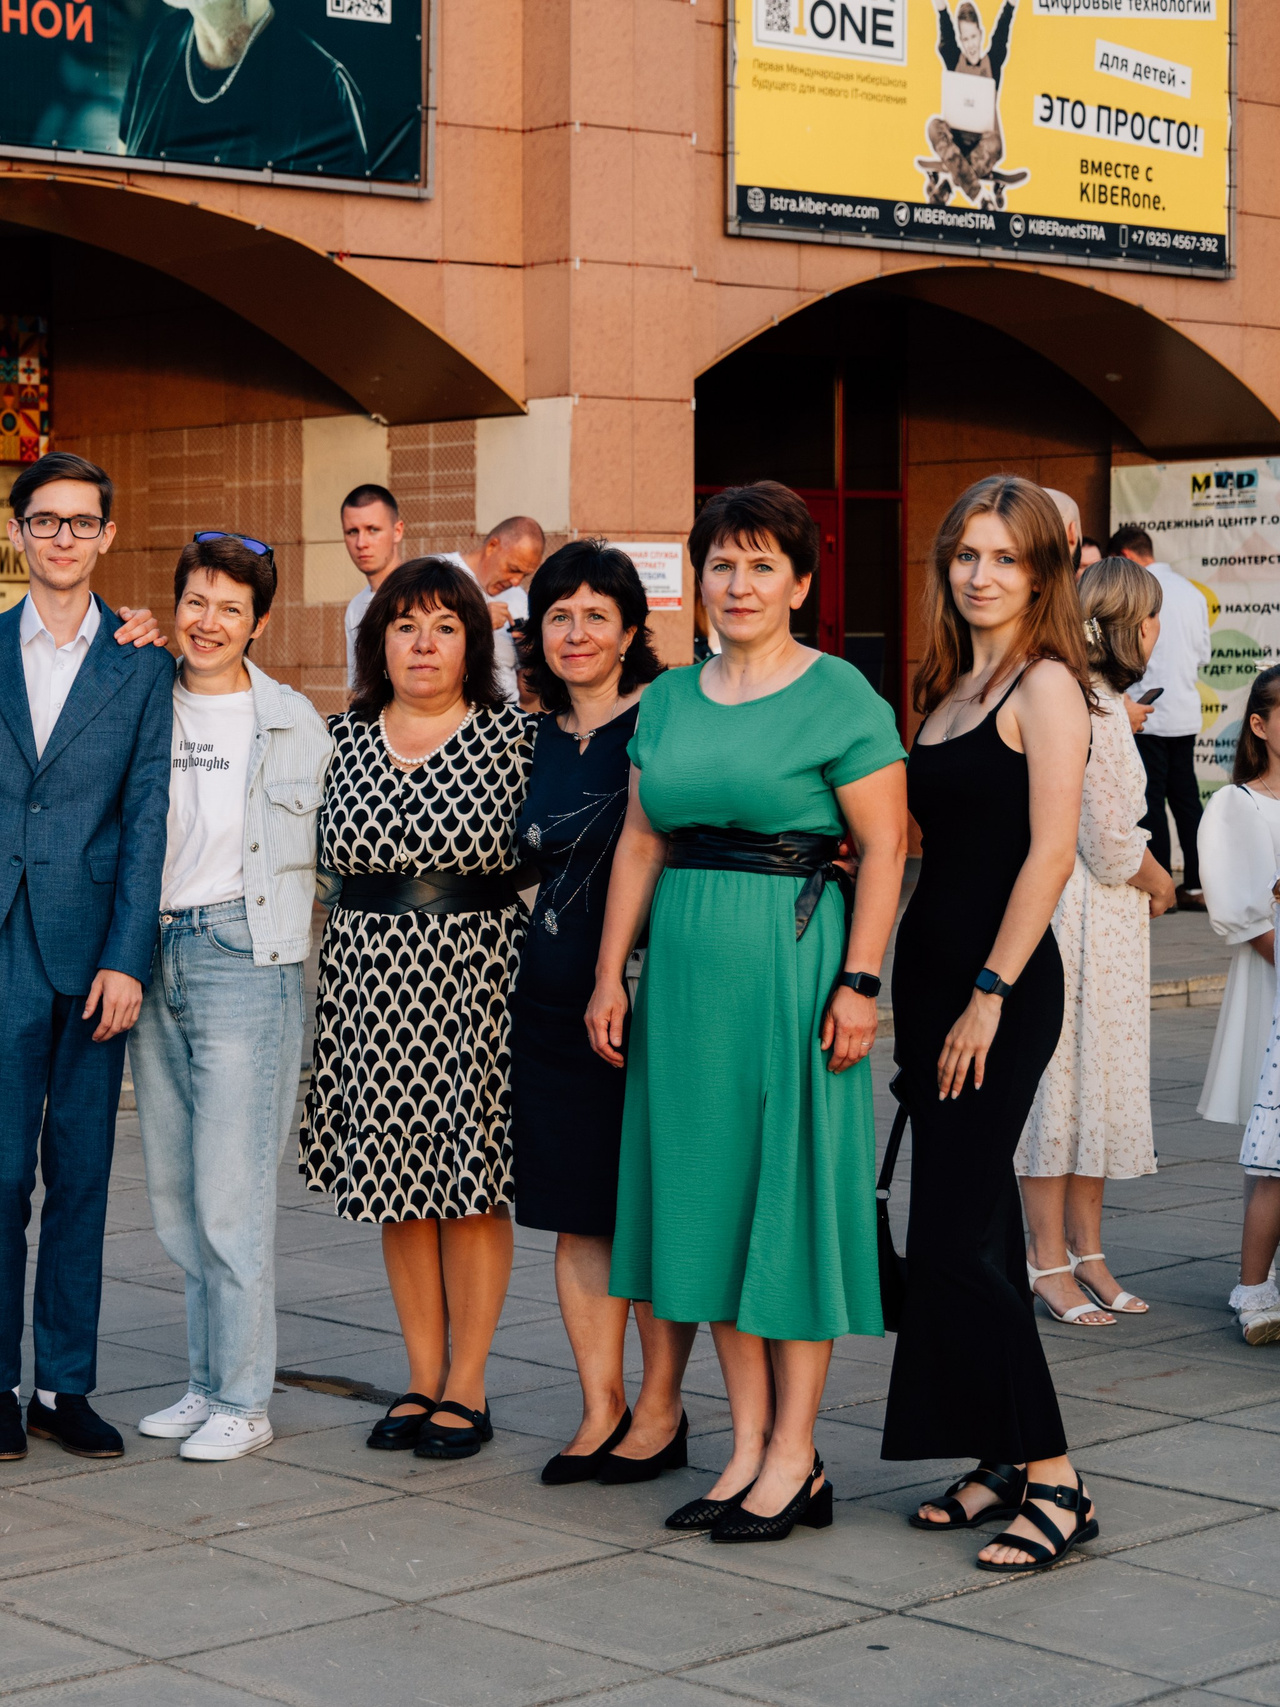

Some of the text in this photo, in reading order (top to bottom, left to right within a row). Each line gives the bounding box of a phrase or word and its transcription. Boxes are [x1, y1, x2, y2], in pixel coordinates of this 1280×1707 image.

[810, 0, 894, 48] ONE
[752, 58, 784, 72] Первая
[786, 63, 854, 81] Международная
[1100, 53, 1128, 73] для
[1133, 62, 1176, 87] детей
[752, 75, 797, 92] будущего
[799, 83, 816, 94] для
[818, 87, 850, 99] нового
[1040, 93, 1198, 152] ЭТО ПРОСТО!
[1080, 159, 1153, 182] вместе с
[770, 192, 880, 220] istra.kiber-one.com
[1080, 182, 1166, 211] KIBERone.
[913, 206, 996, 231] KIBERoneISTRA
[1028, 218, 1106, 241] KIBERoneISTRA
[1131, 230, 1219, 253] +7 (925) 4567-392
[1218, 516, 1257, 528] ЦЕНТР
[1212, 604, 1221, 614] И
[1211, 644, 1272, 658] УАЛЬНЫЙ
[1203, 664, 1232, 677] ГДЕ?
[197, 744, 214, 753] you
[1197, 738, 1238, 748] АЛЬНО
[173, 758, 188, 772] my
